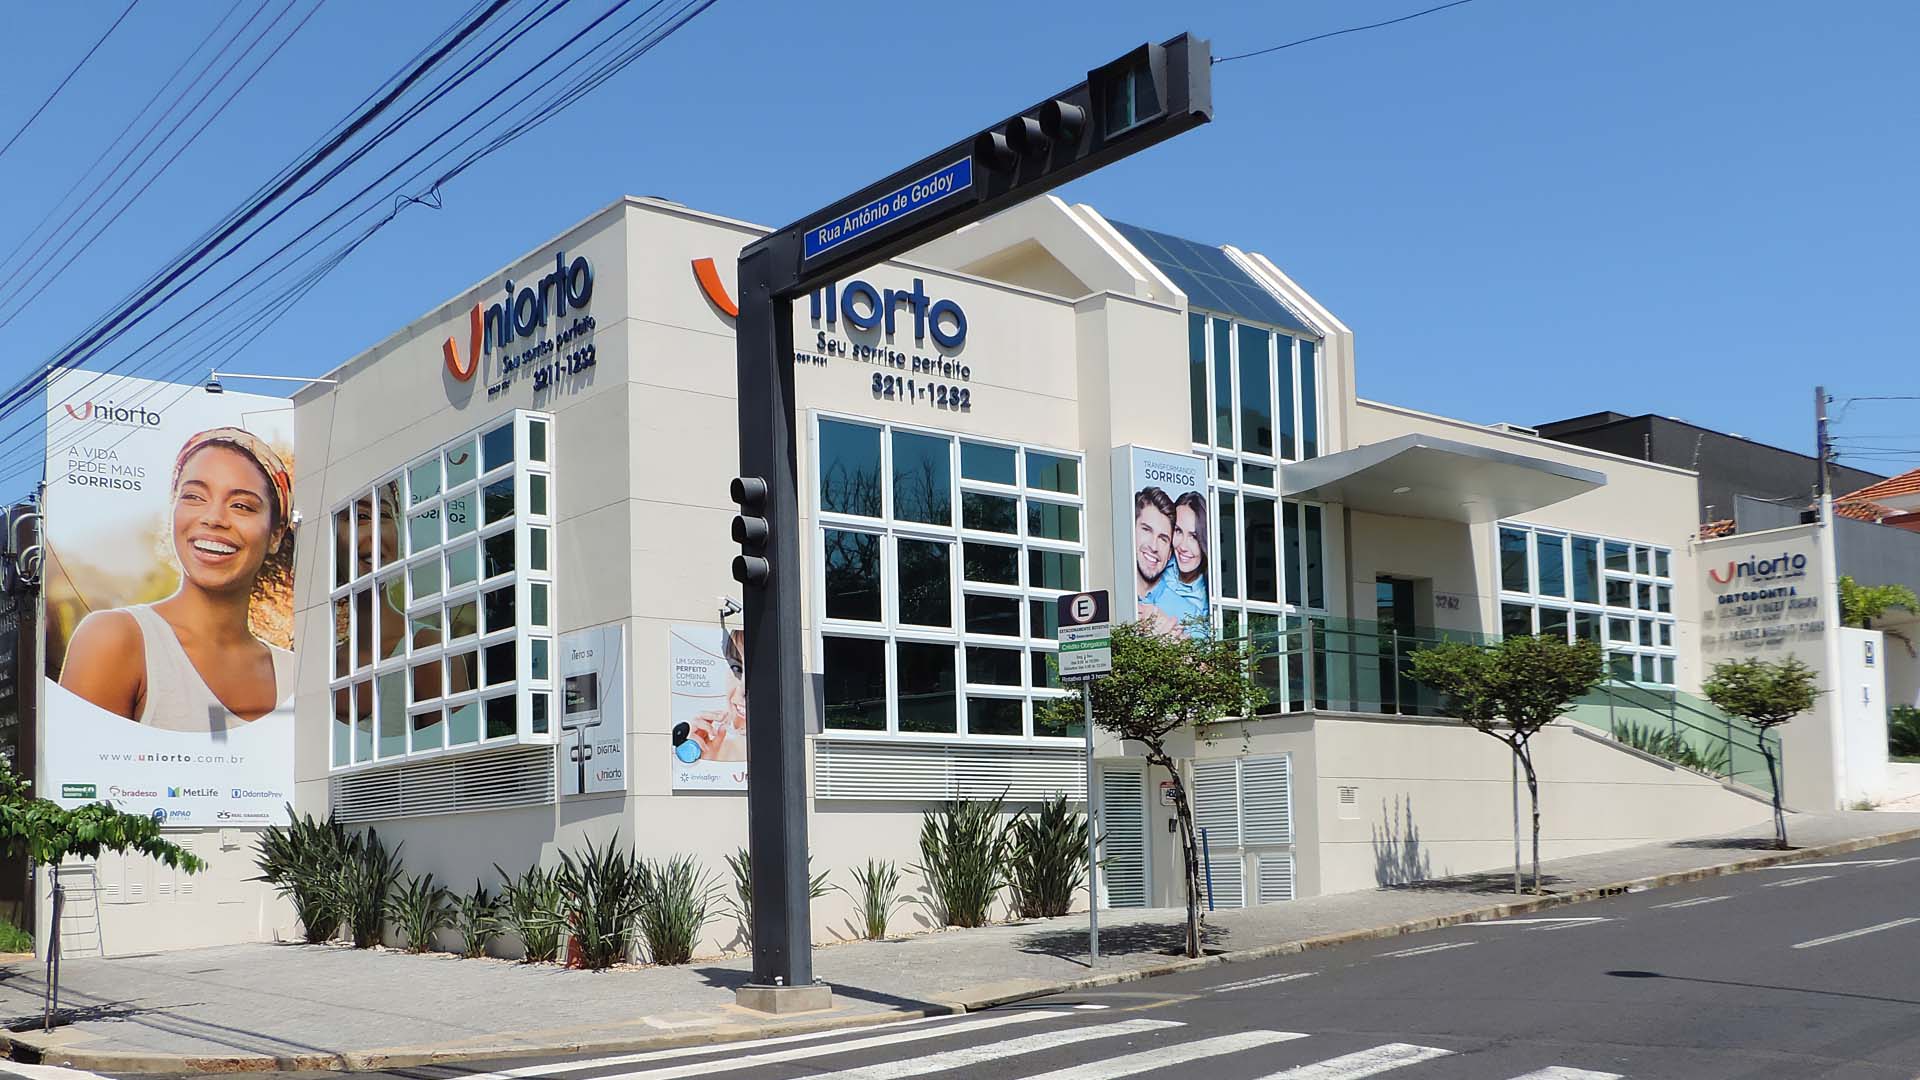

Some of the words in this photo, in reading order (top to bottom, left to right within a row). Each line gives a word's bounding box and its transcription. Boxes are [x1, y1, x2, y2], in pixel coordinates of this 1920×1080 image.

[818, 224, 841, 246] Rua
[842, 202, 890, 236] Antônio
[892, 193, 908, 212] de
[911, 172, 955, 203] Godoy
[442, 250, 594, 383] Uniorto
[503, 355, 520, 374] Seu
[522, 338, 555, 365] sorriso
[556, 315, 596, 352] perfeito
[816, 331, 847, 355] Seu
[852, 344, 906, 368] sorriso
[911, 353, 971, 380] perfeito
[533, 344, 597, 391] 3211-1232
[872, 372, 971, 408] 3211-1232
[64, 401, 161, 426] Uniorto
[68, 446, 79, 456] A
[83, 447, 119, 461] VIDA
[68, 460, 107, 474] PEDE
[111, 461, 146, 478] MAIS
[1145, 468, 1195, 487] SORRISOS
[68, 474, 142, 491] SORRISOS
[1709, 552, 1807, 584] Uniorto
[1718, 586, 1797, 604] ORTODONTIA
[1077, 600, 1089, 617] E
[676, 665, 707, 673] PERFEITO
[688, 658, 716, 667] SORRISO
[676, 679, 692, 687] COM
[692, 679, 710, 688] VOCÊ
[99, 752, 245, 764] www.uniorto.com.br
[597, 744, 620, 755] DIGITAL
[596, 767, 622, 781] Uniorto
[121, 789, 158, 798] bradesco
[183, 788, 219, 797] MetLife
